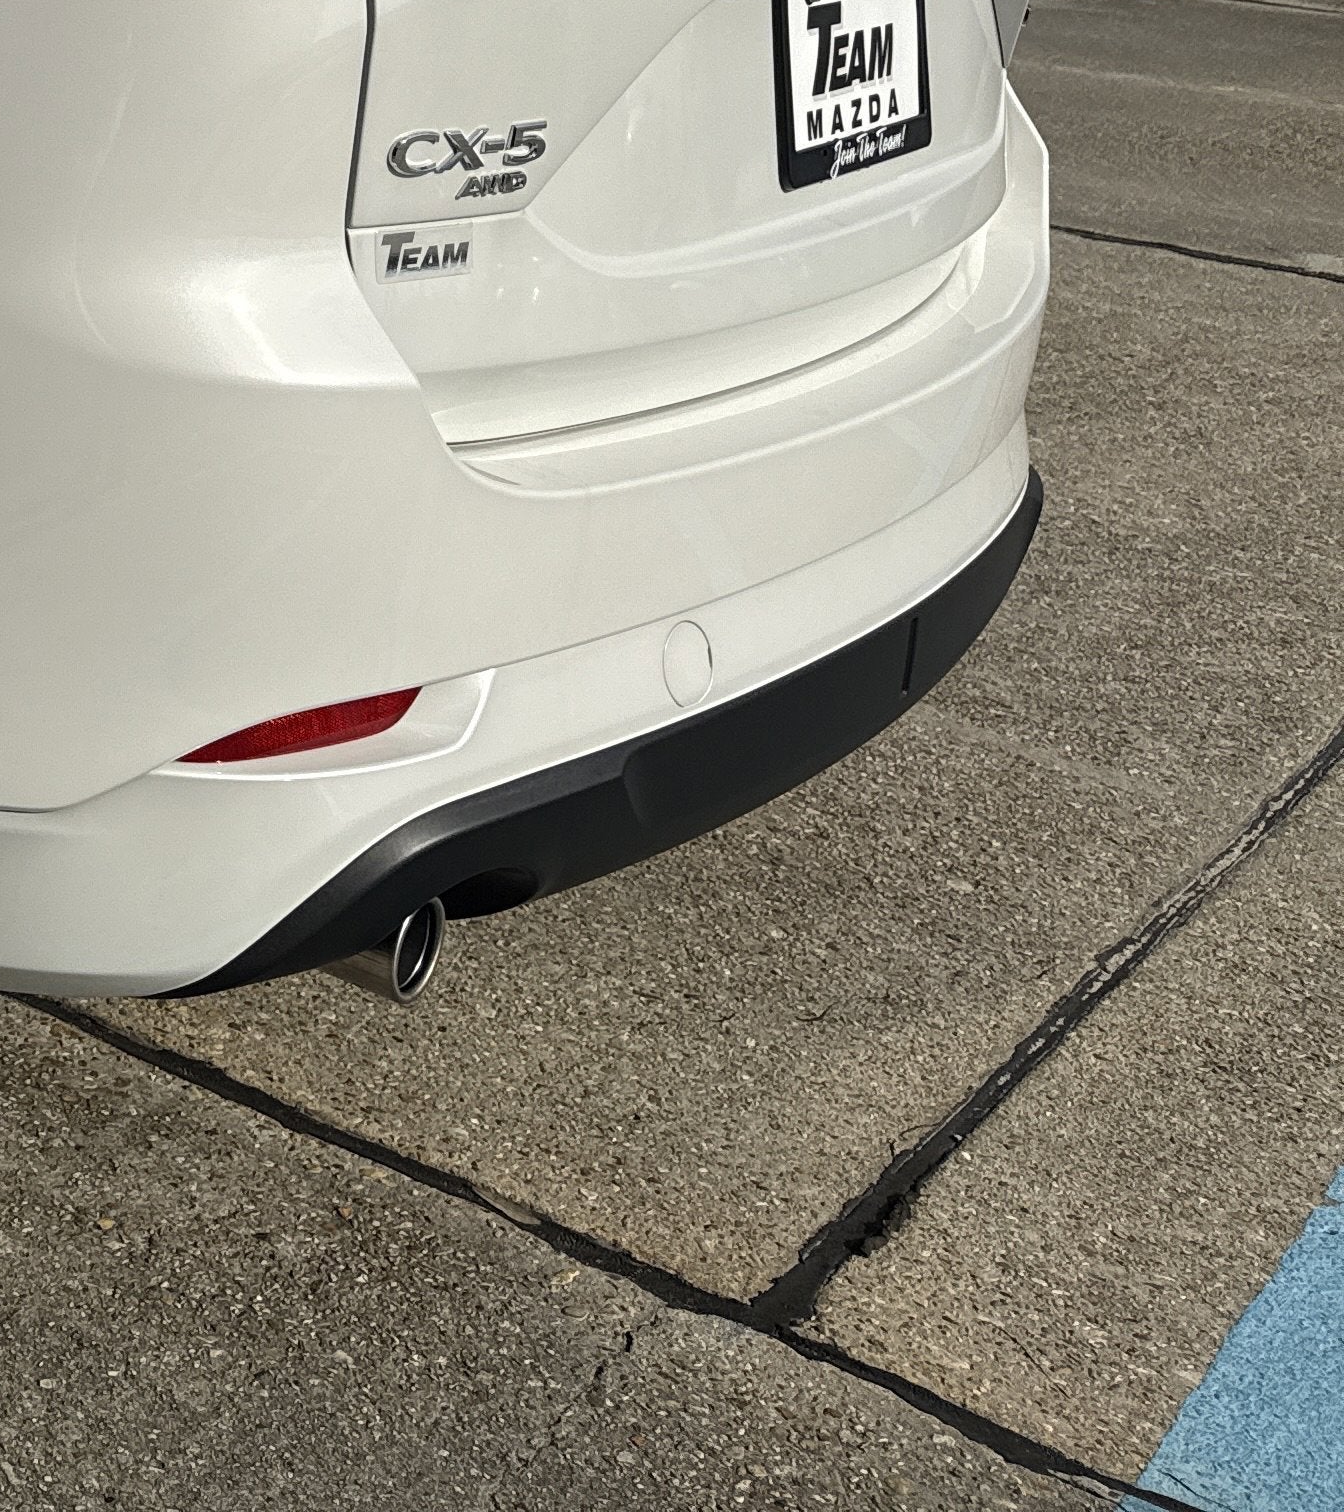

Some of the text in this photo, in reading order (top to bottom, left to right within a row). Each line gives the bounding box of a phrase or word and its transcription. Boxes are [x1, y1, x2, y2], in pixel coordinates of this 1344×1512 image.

[807, 1, 894, 97] TEAM
[806, 88, 900, 141] MAZDA
[386, 120, 548, 178] CX-5
[830, 140, 856, 178] Join
[856, 134, 877, 163] The
[454, 170, 528, 201] AWD
[380, 230, 470, 279] TEAM
